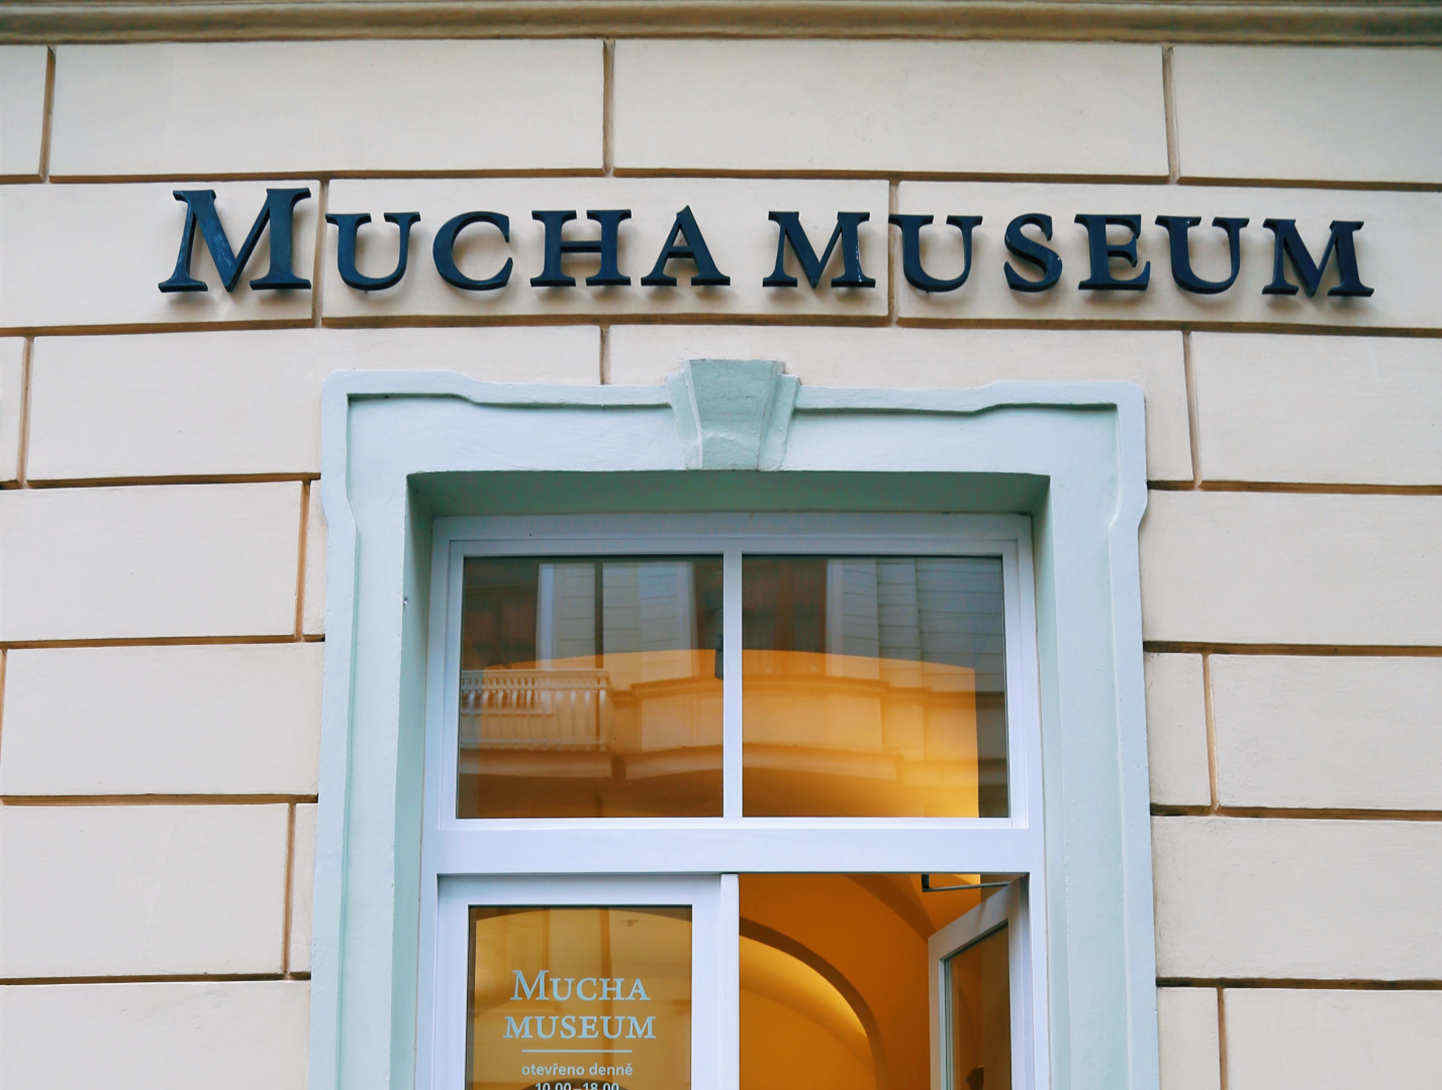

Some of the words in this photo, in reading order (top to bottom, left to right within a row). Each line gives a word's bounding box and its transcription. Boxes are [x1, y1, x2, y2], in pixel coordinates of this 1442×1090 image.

[158, 187, 731, 293] MUCHA
[762, 211, 1375, 297] MUSEUM
[510, 969, 650, 1001] MUCHA
[503, 1016, 656, 1039] MUSEUM
